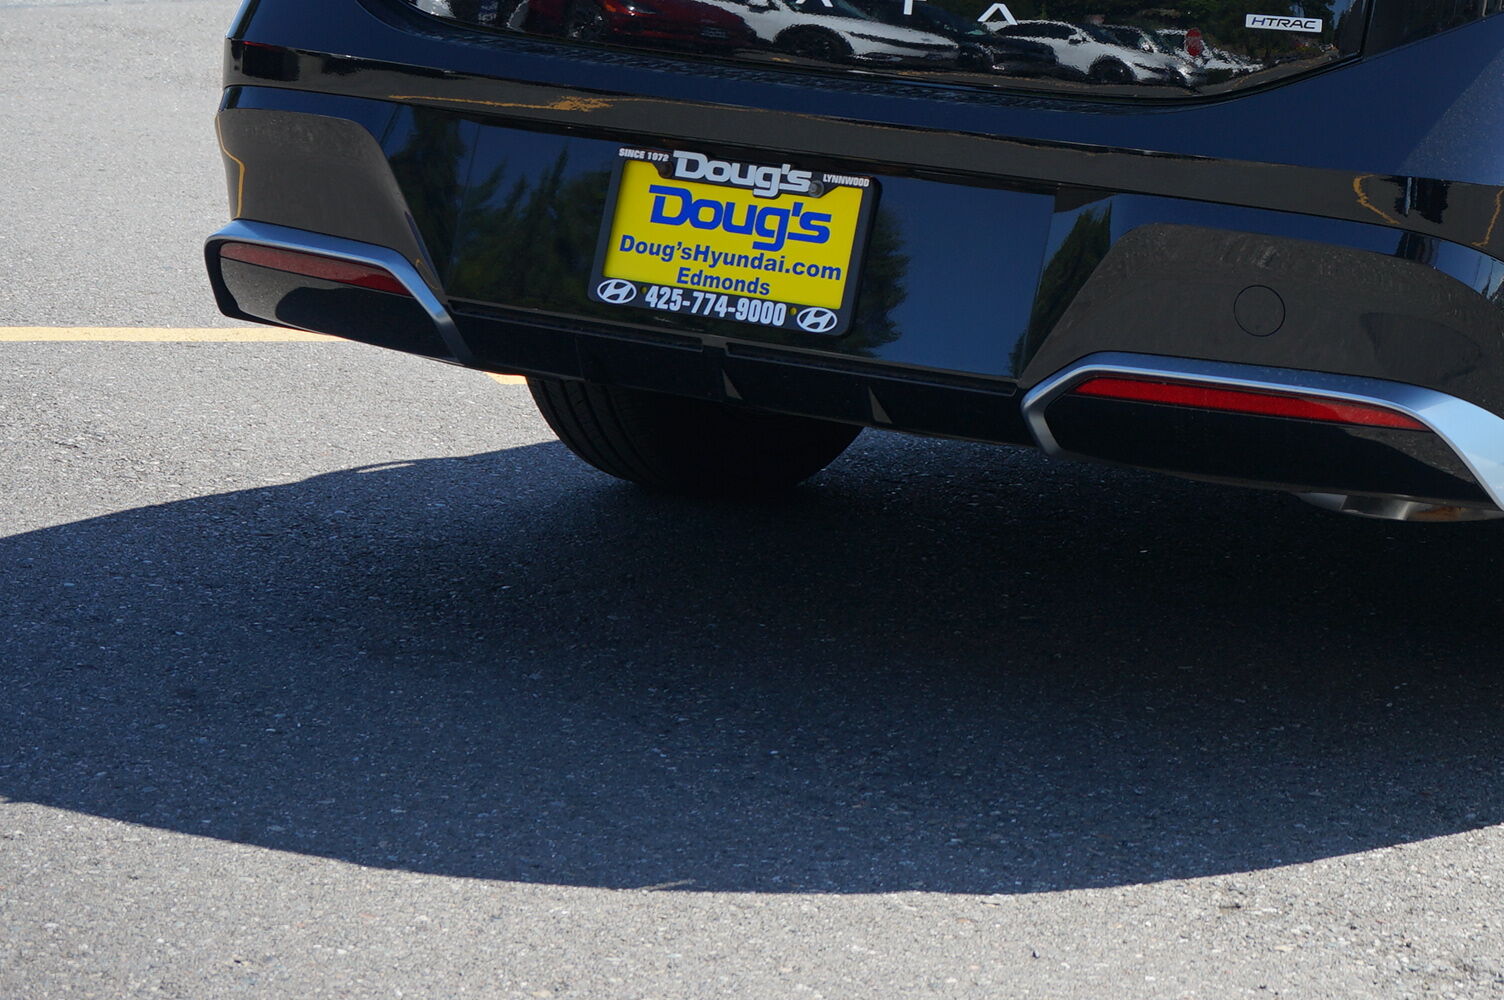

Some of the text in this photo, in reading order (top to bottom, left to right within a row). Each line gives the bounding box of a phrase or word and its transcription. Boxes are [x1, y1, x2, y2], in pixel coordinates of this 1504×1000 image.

[1251, 16, 1317, 30] HTRAC
[618, 147, 670, 163] SINCE 1972
[673, 150, 812, 197] Doug's
[822, 173, 870, 188] LYNNWOOD
[649, 184, 832, 252] Doug's
[619, 234, 842, 281] Doug'sHyundai.com
[676, 267, 771, 296] Edmonds
[645, 285, 787, 327] 425-774-9000
